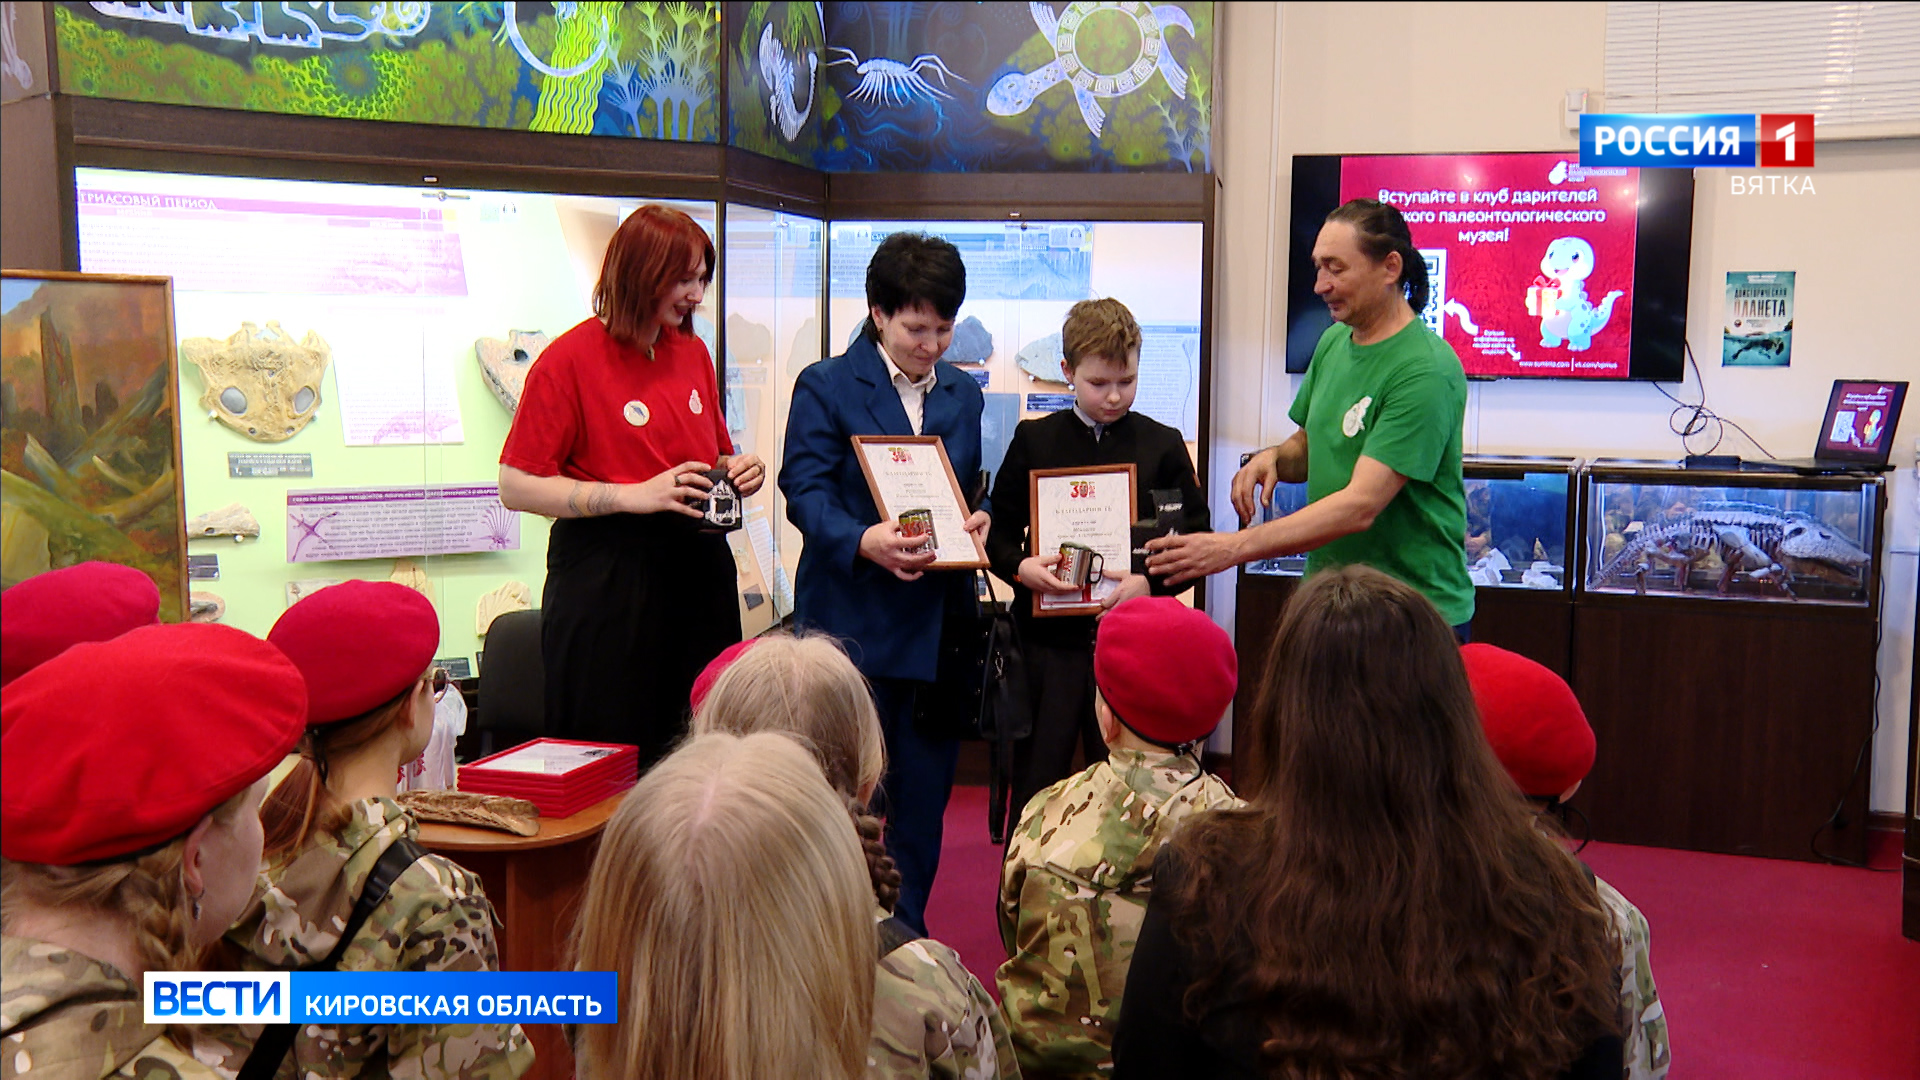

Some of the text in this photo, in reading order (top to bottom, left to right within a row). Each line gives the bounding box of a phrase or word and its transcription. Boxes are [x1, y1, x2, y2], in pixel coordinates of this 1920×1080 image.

[165, 196, 218, 211] ПЕРИОД
[1378, 188, 1598, 206] Вступайте в клуб дарителей
[1438, 209, 1607, 224] палеонтологического
[1458, 228, 1510, 244] музея!
[1733, 298, 1786, 317] ПЛАНЕТА
[1069, 481, 1089, 499] 30
